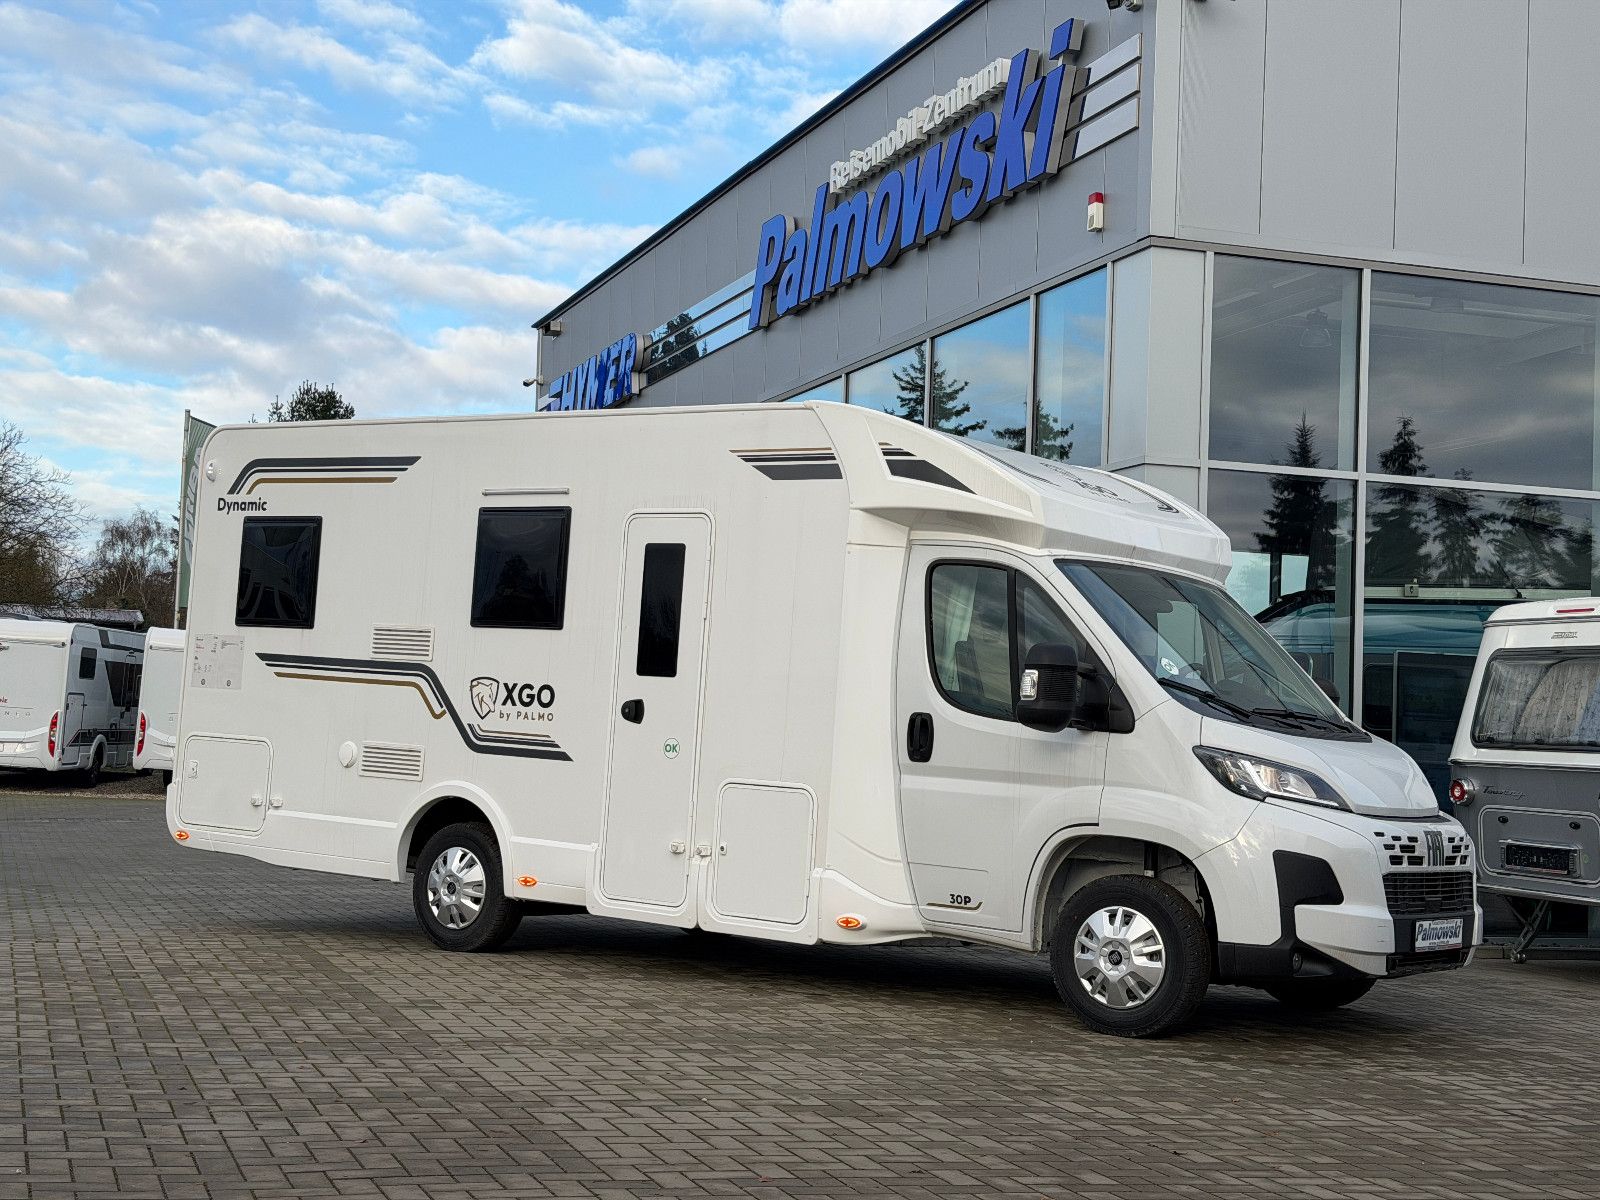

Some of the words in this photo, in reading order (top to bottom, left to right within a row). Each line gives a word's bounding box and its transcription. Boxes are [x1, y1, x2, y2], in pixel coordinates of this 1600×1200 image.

[749, 18, 1077, 330] Palmowski
[217, 497, 267, 515] Dynamic
[501, 682, 556, 708] XGO
[499, 710, 511, 721] by
[516, 711, 554, 721] PALMO
[665, 743, 678, 753] OK
[949, 893, 972, 905] 30P
[1415, 920, 1462, 942] Palmowski
